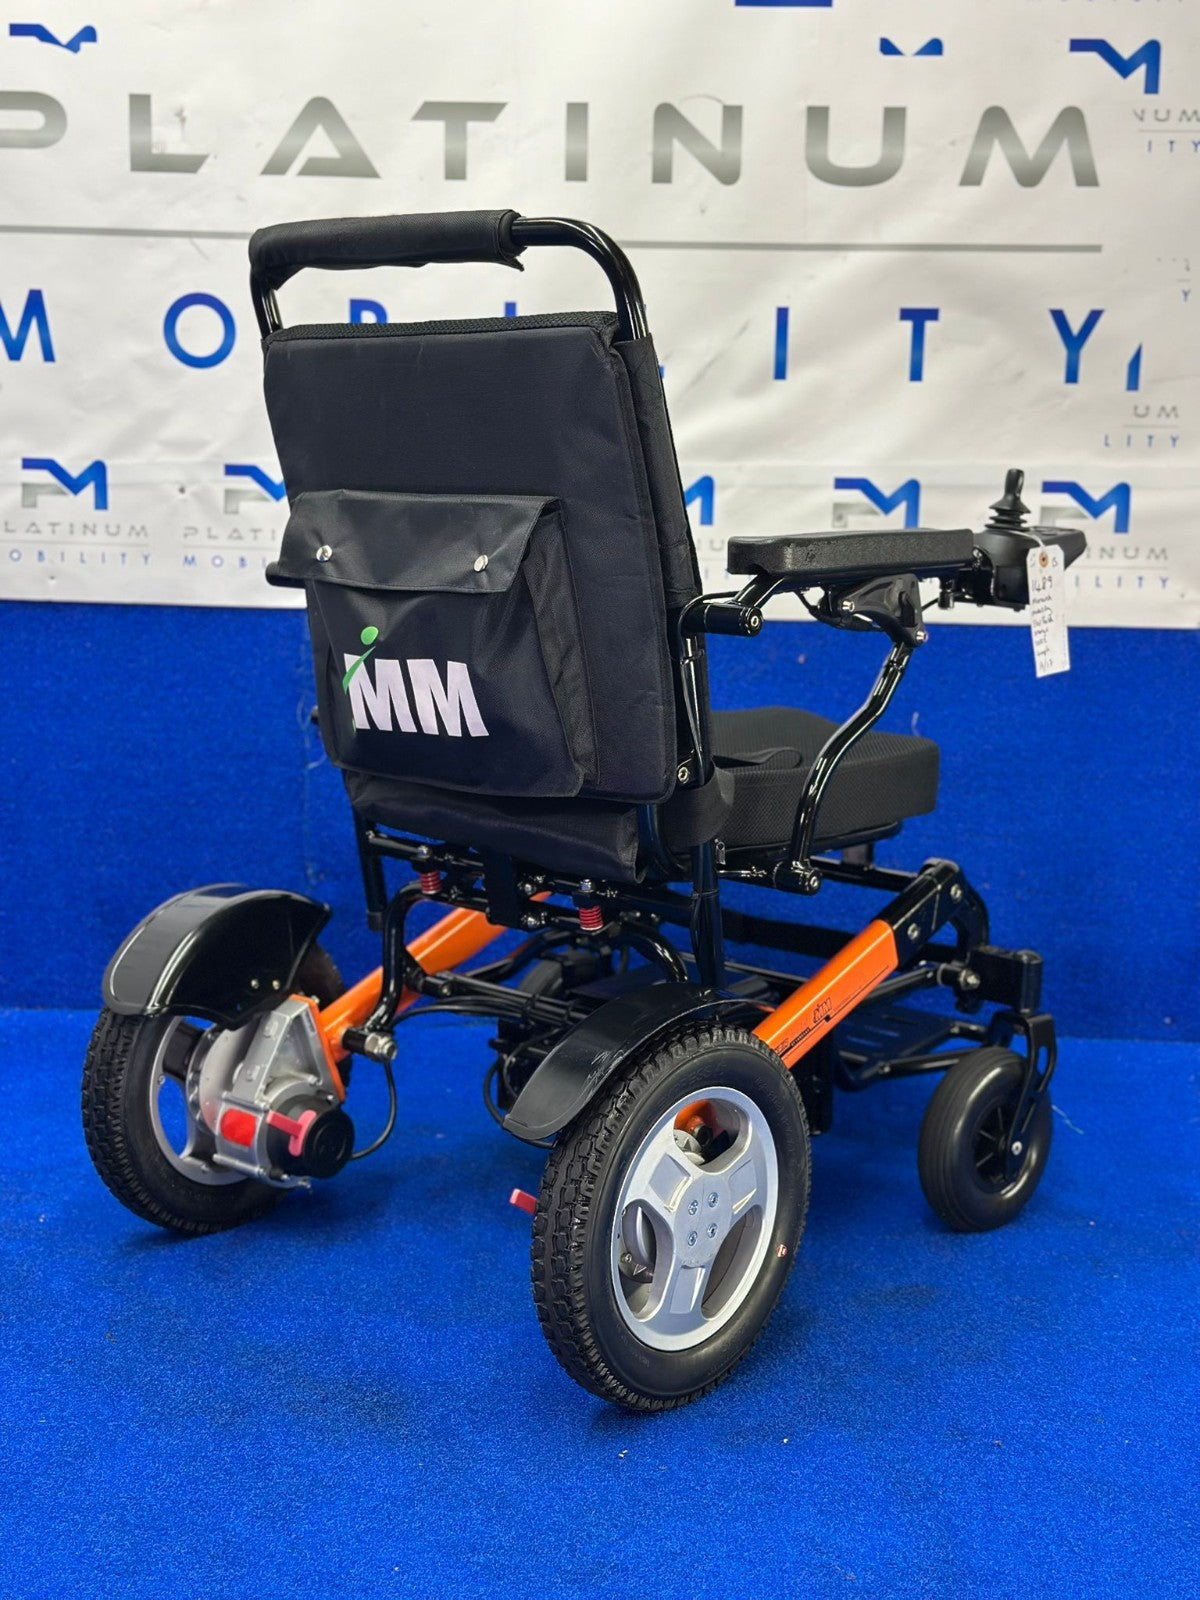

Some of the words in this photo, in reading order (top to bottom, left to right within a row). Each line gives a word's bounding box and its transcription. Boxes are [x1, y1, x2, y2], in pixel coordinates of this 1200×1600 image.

[0, 91, 1100, 188] PLATINUM
[0, 288, 1105, 384] MOITY
[3, 520, 149, 538] LATINUM
[183, 526, 277, 542] PLATI
[8, 549, 150, 566] OBILITY
[183, 554, 267, 569] MOBI
[1086, 547, 1169, 561] INUM
[1074, 575, 1169, 589] ILITY
